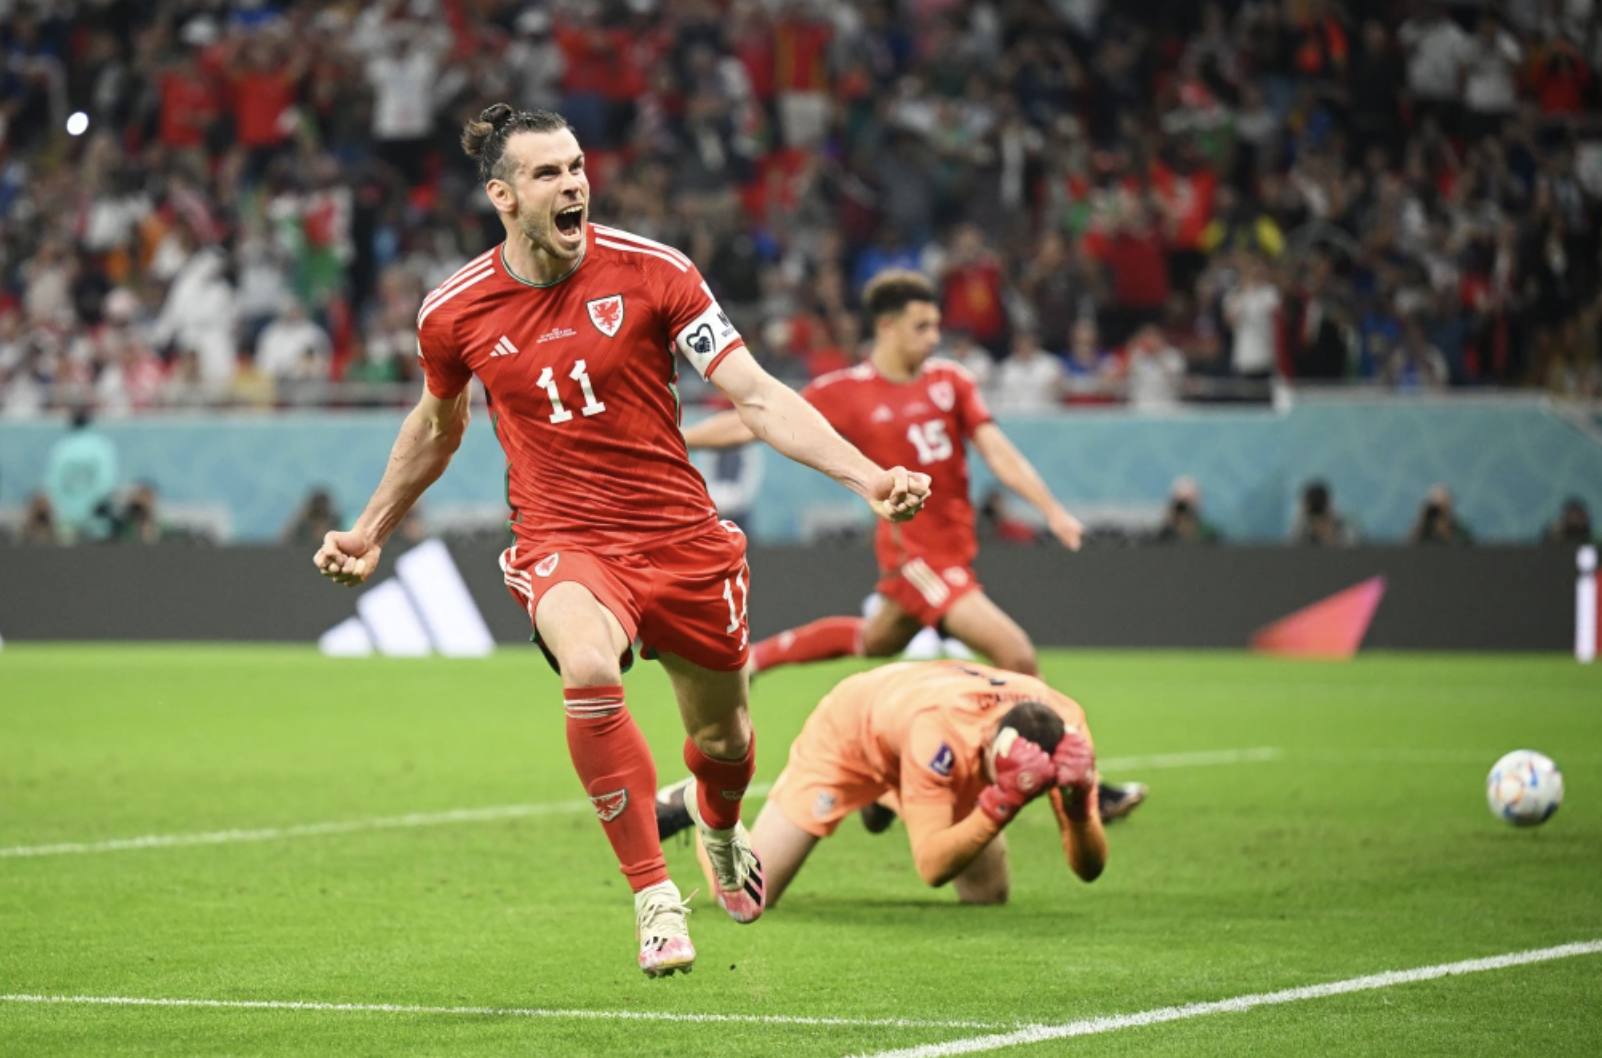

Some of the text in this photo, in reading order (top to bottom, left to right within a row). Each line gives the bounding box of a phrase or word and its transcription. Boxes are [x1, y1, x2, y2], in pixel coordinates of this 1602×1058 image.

[536, 359, 606, 424] 11
[907, 419, 953, 465] 15
[722, 564, 748, 636] 11
